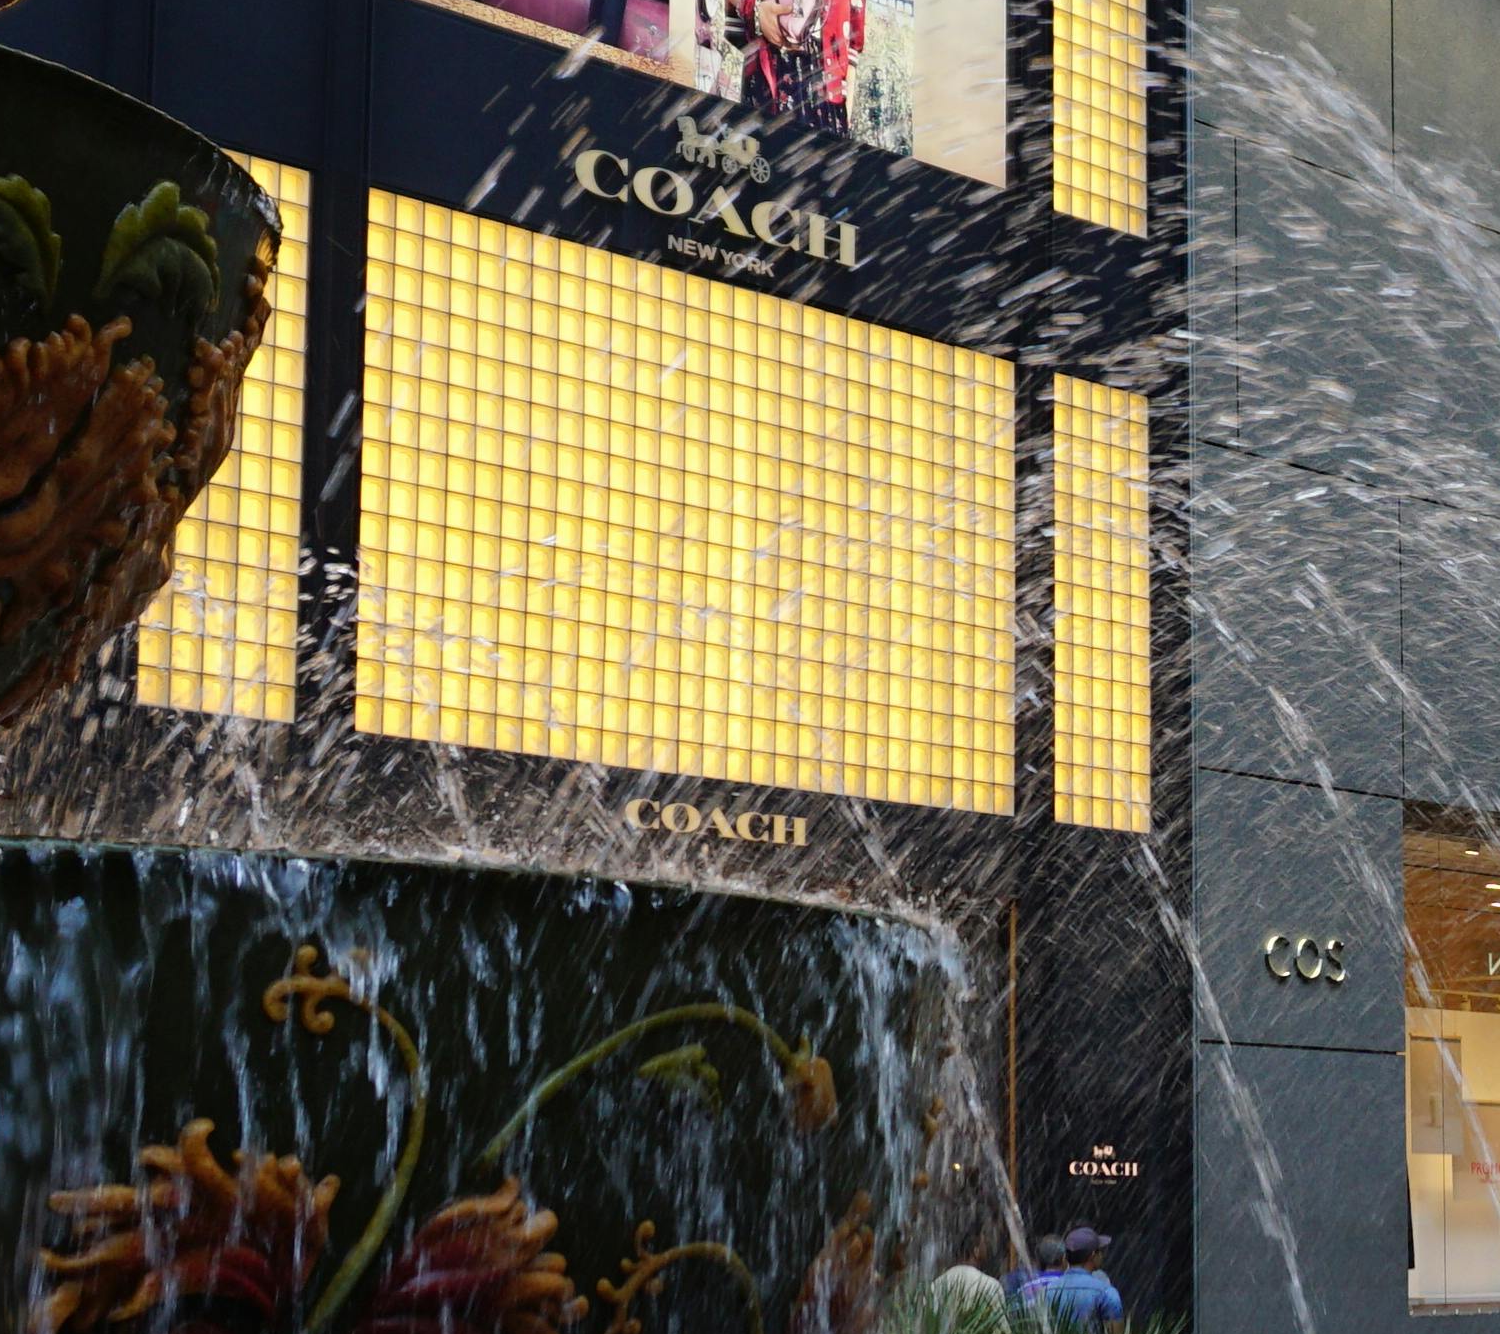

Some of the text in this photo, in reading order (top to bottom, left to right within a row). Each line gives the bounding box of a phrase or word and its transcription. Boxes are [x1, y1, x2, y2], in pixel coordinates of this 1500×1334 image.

[574, 148, 859, 267] COACH
[668, 235, 775, 278] NEW YORK
[625, 798, 811, 847] COACH
[1264, 934, 1347, 983] COS
[1069, 1161, 1138, 1176] COACH
